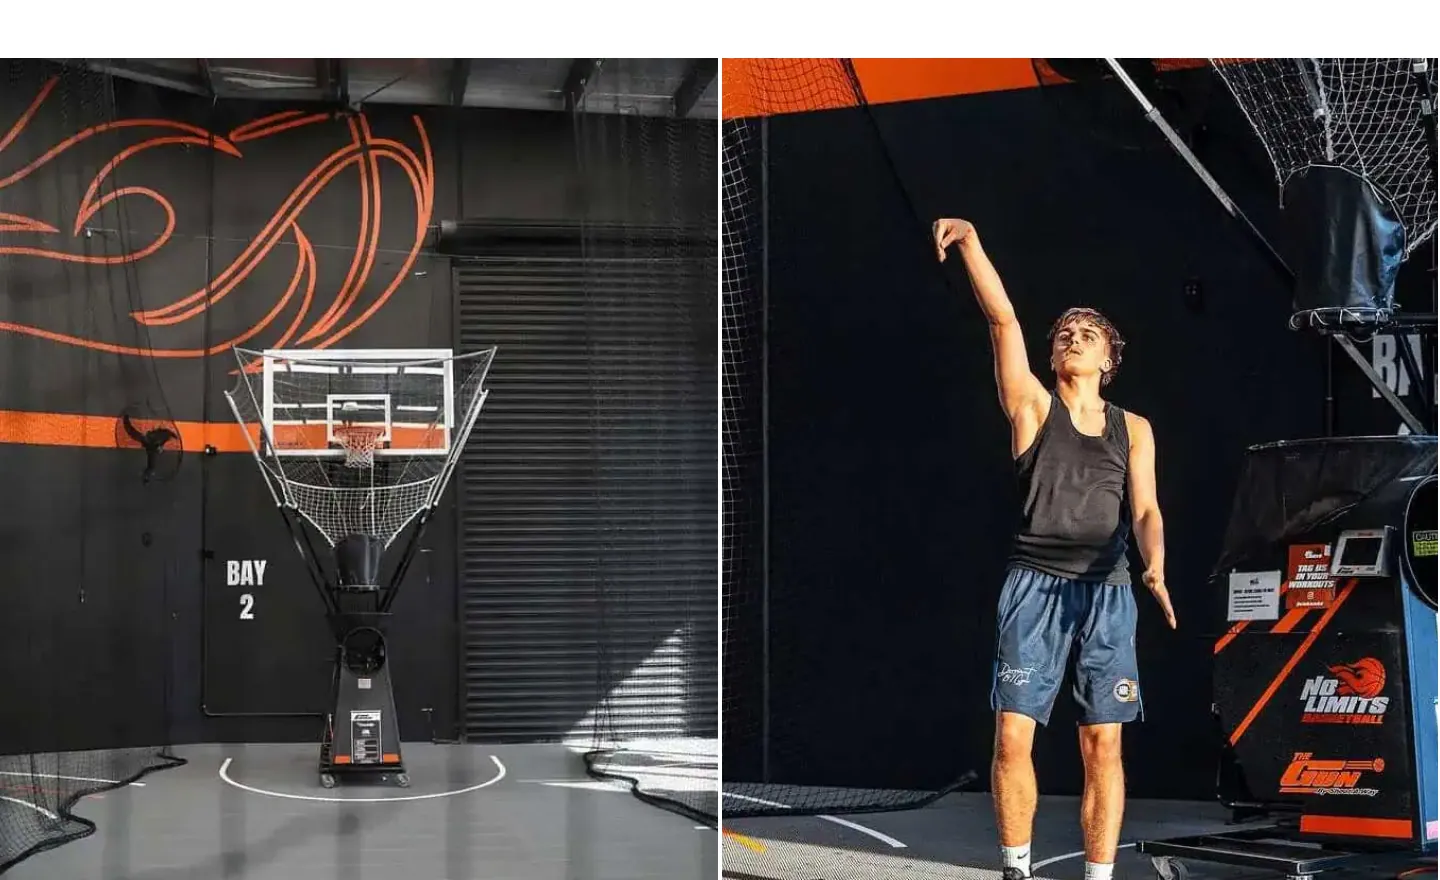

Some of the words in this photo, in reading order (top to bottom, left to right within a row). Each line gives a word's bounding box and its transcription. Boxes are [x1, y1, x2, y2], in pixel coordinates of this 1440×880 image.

[1372, 333, 1438, 405] BA
[226, 559, 267, 587] BAY
[239, 593, 254, 620] 2
[1304, 697, 1389, 714] LIMITS
